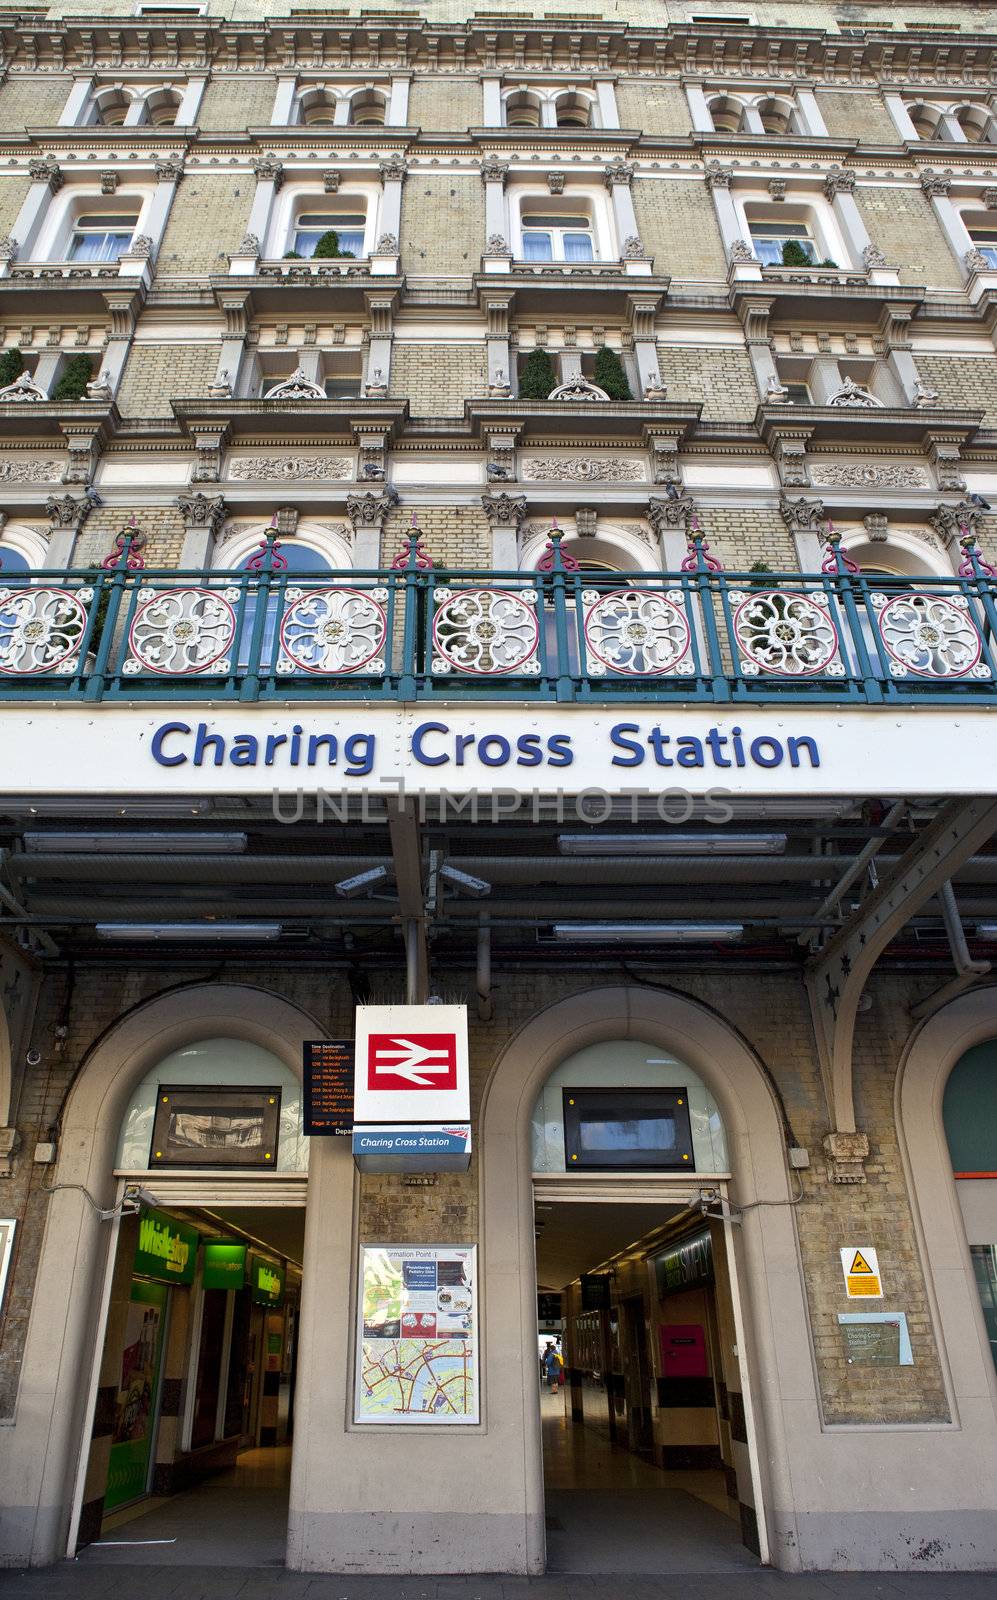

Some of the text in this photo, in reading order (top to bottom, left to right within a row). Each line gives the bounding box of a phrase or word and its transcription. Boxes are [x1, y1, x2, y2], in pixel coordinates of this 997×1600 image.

[151, 721, 821, 777] Charing Cross Station
[360, 1137, 450, 1149] Charing Cross Station
[387, 1250, 432, 1258] ormation Point
